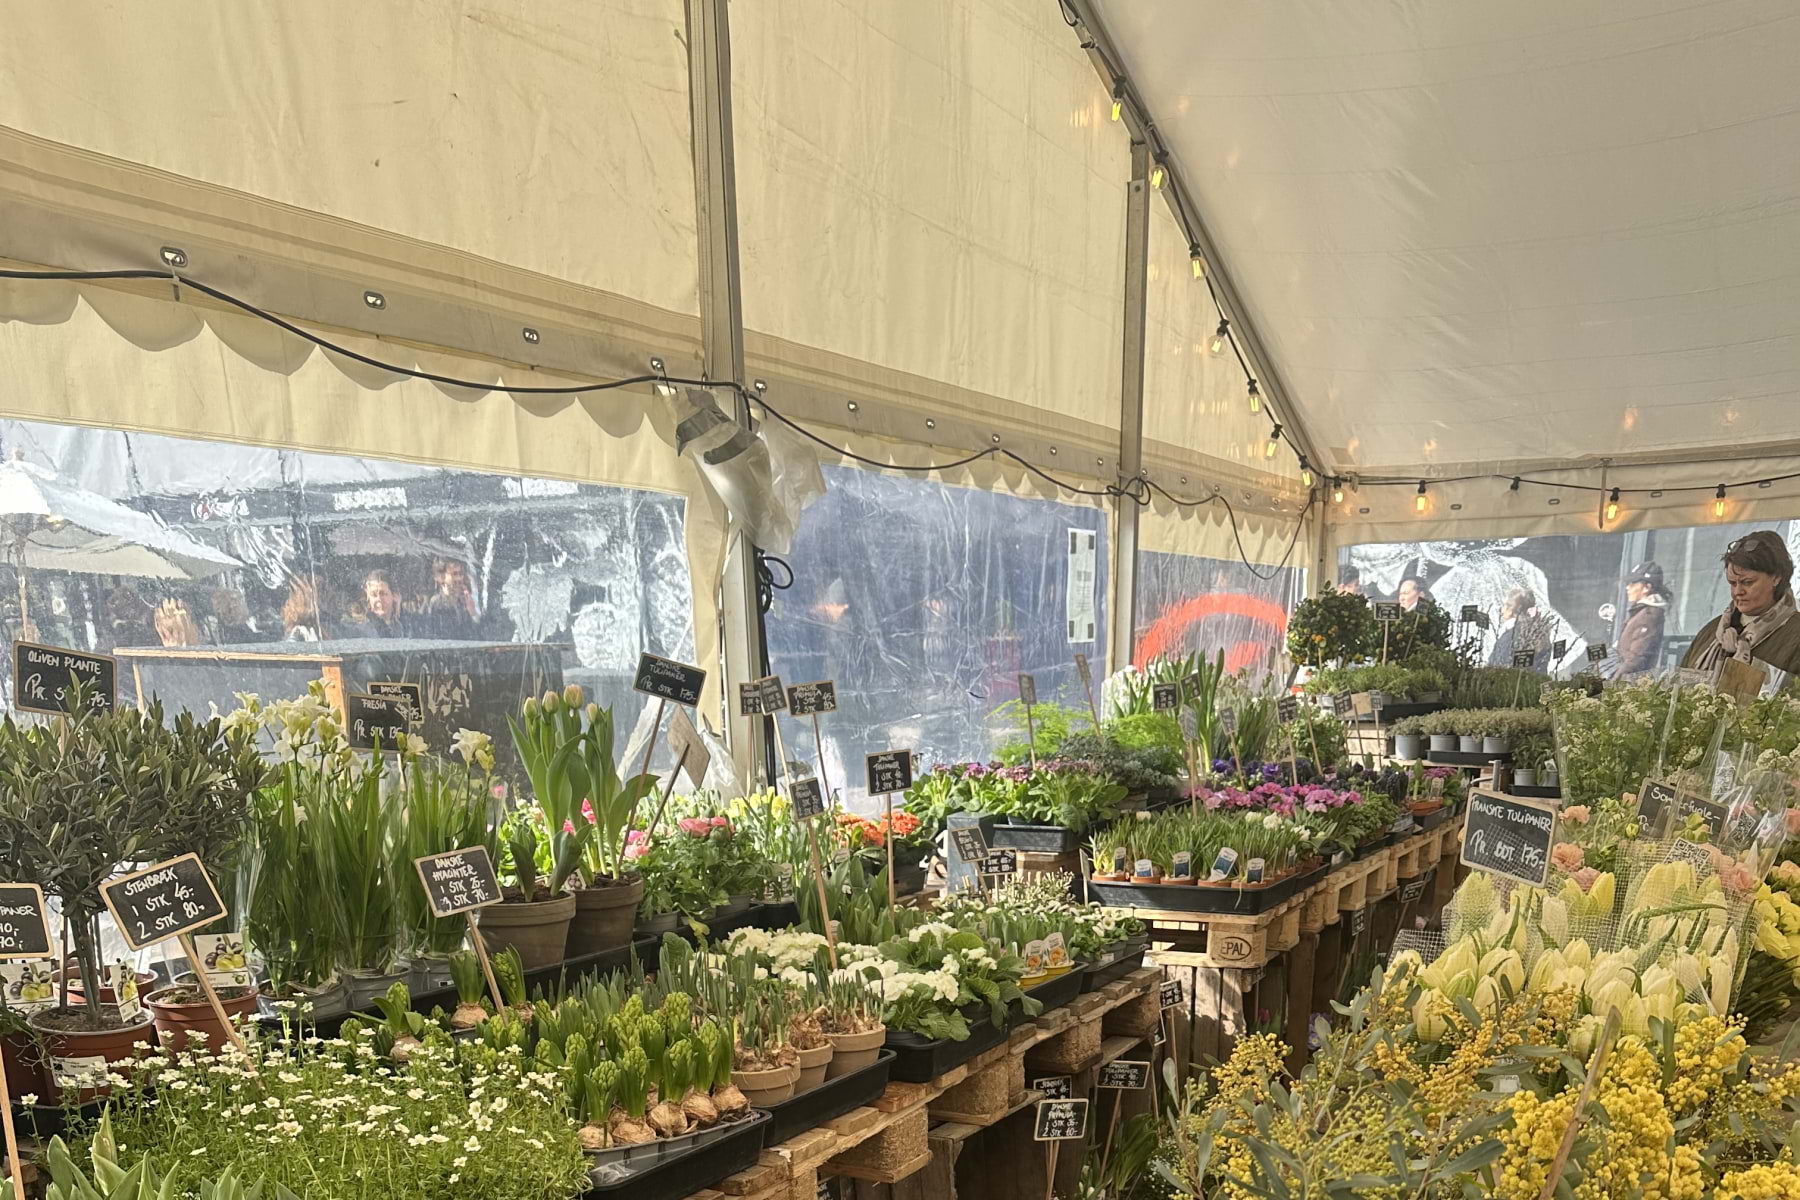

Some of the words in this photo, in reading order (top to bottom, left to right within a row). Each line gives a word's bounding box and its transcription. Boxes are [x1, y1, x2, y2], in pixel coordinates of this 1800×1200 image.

[64, 656, 102, 675] PLANTE
[657, 683, 673, 696] STK
[1471, 794, 1505, 819] FRANSKE
[434, 855, 465, 869] DANSKE
[449, 879, 468, 894] STK
[131, 904, 140, 917] 1
[145, 893, 172, 912] STK
[453, 893, 473, 906] STK
[136, 921, 152, 940] 2
[154, 911, 180, 931] STK
[1051, 1119, 1065, 1128] STK
[1049, 1128, 1063, 1137] STK
